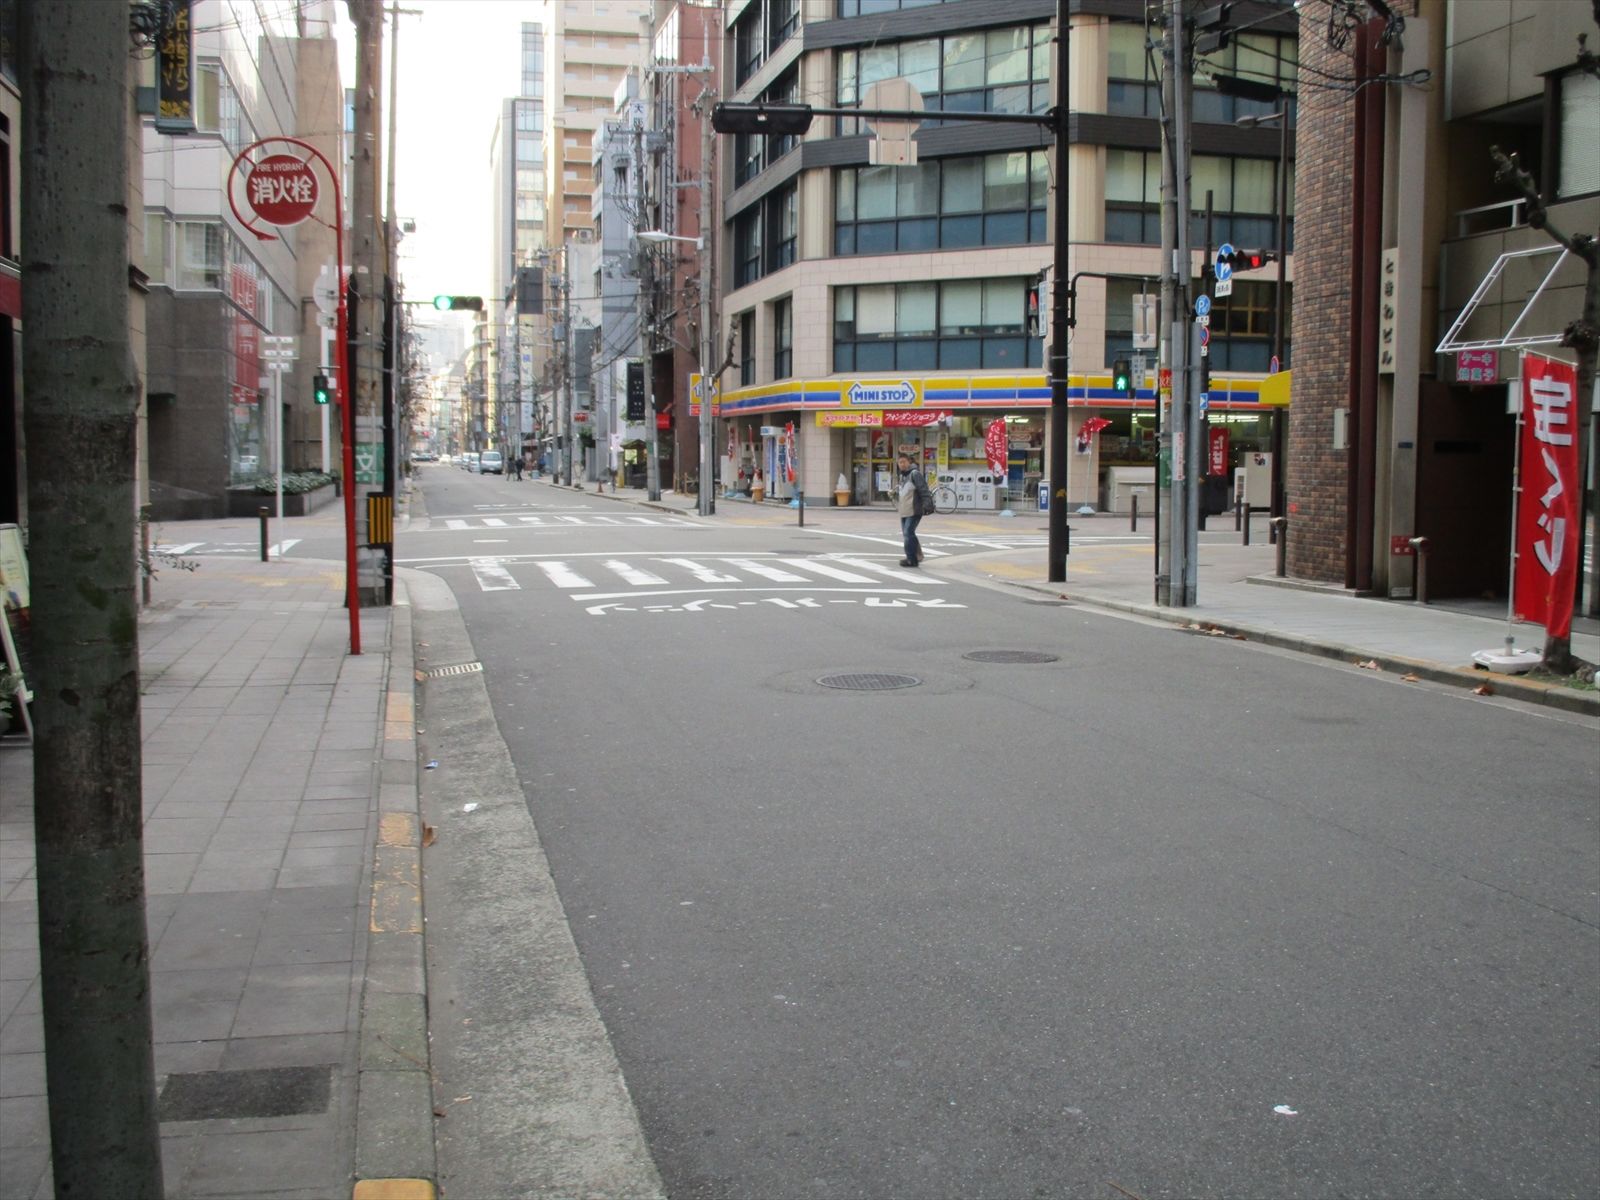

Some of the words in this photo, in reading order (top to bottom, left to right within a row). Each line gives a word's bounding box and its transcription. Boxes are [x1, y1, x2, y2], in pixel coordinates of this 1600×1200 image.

[256, 163, 272, 172] FIRE
[273, 162, 305, 172] HYDRANT
[251, 174, 314, 205] 消火栓
[1461, 351, 1493, 366] ケーキ
[854, 390, 880, 401] MINI
[881, 390, 909, 401] STOP
[885, 412, 936, 421] フォンダンショコラ
